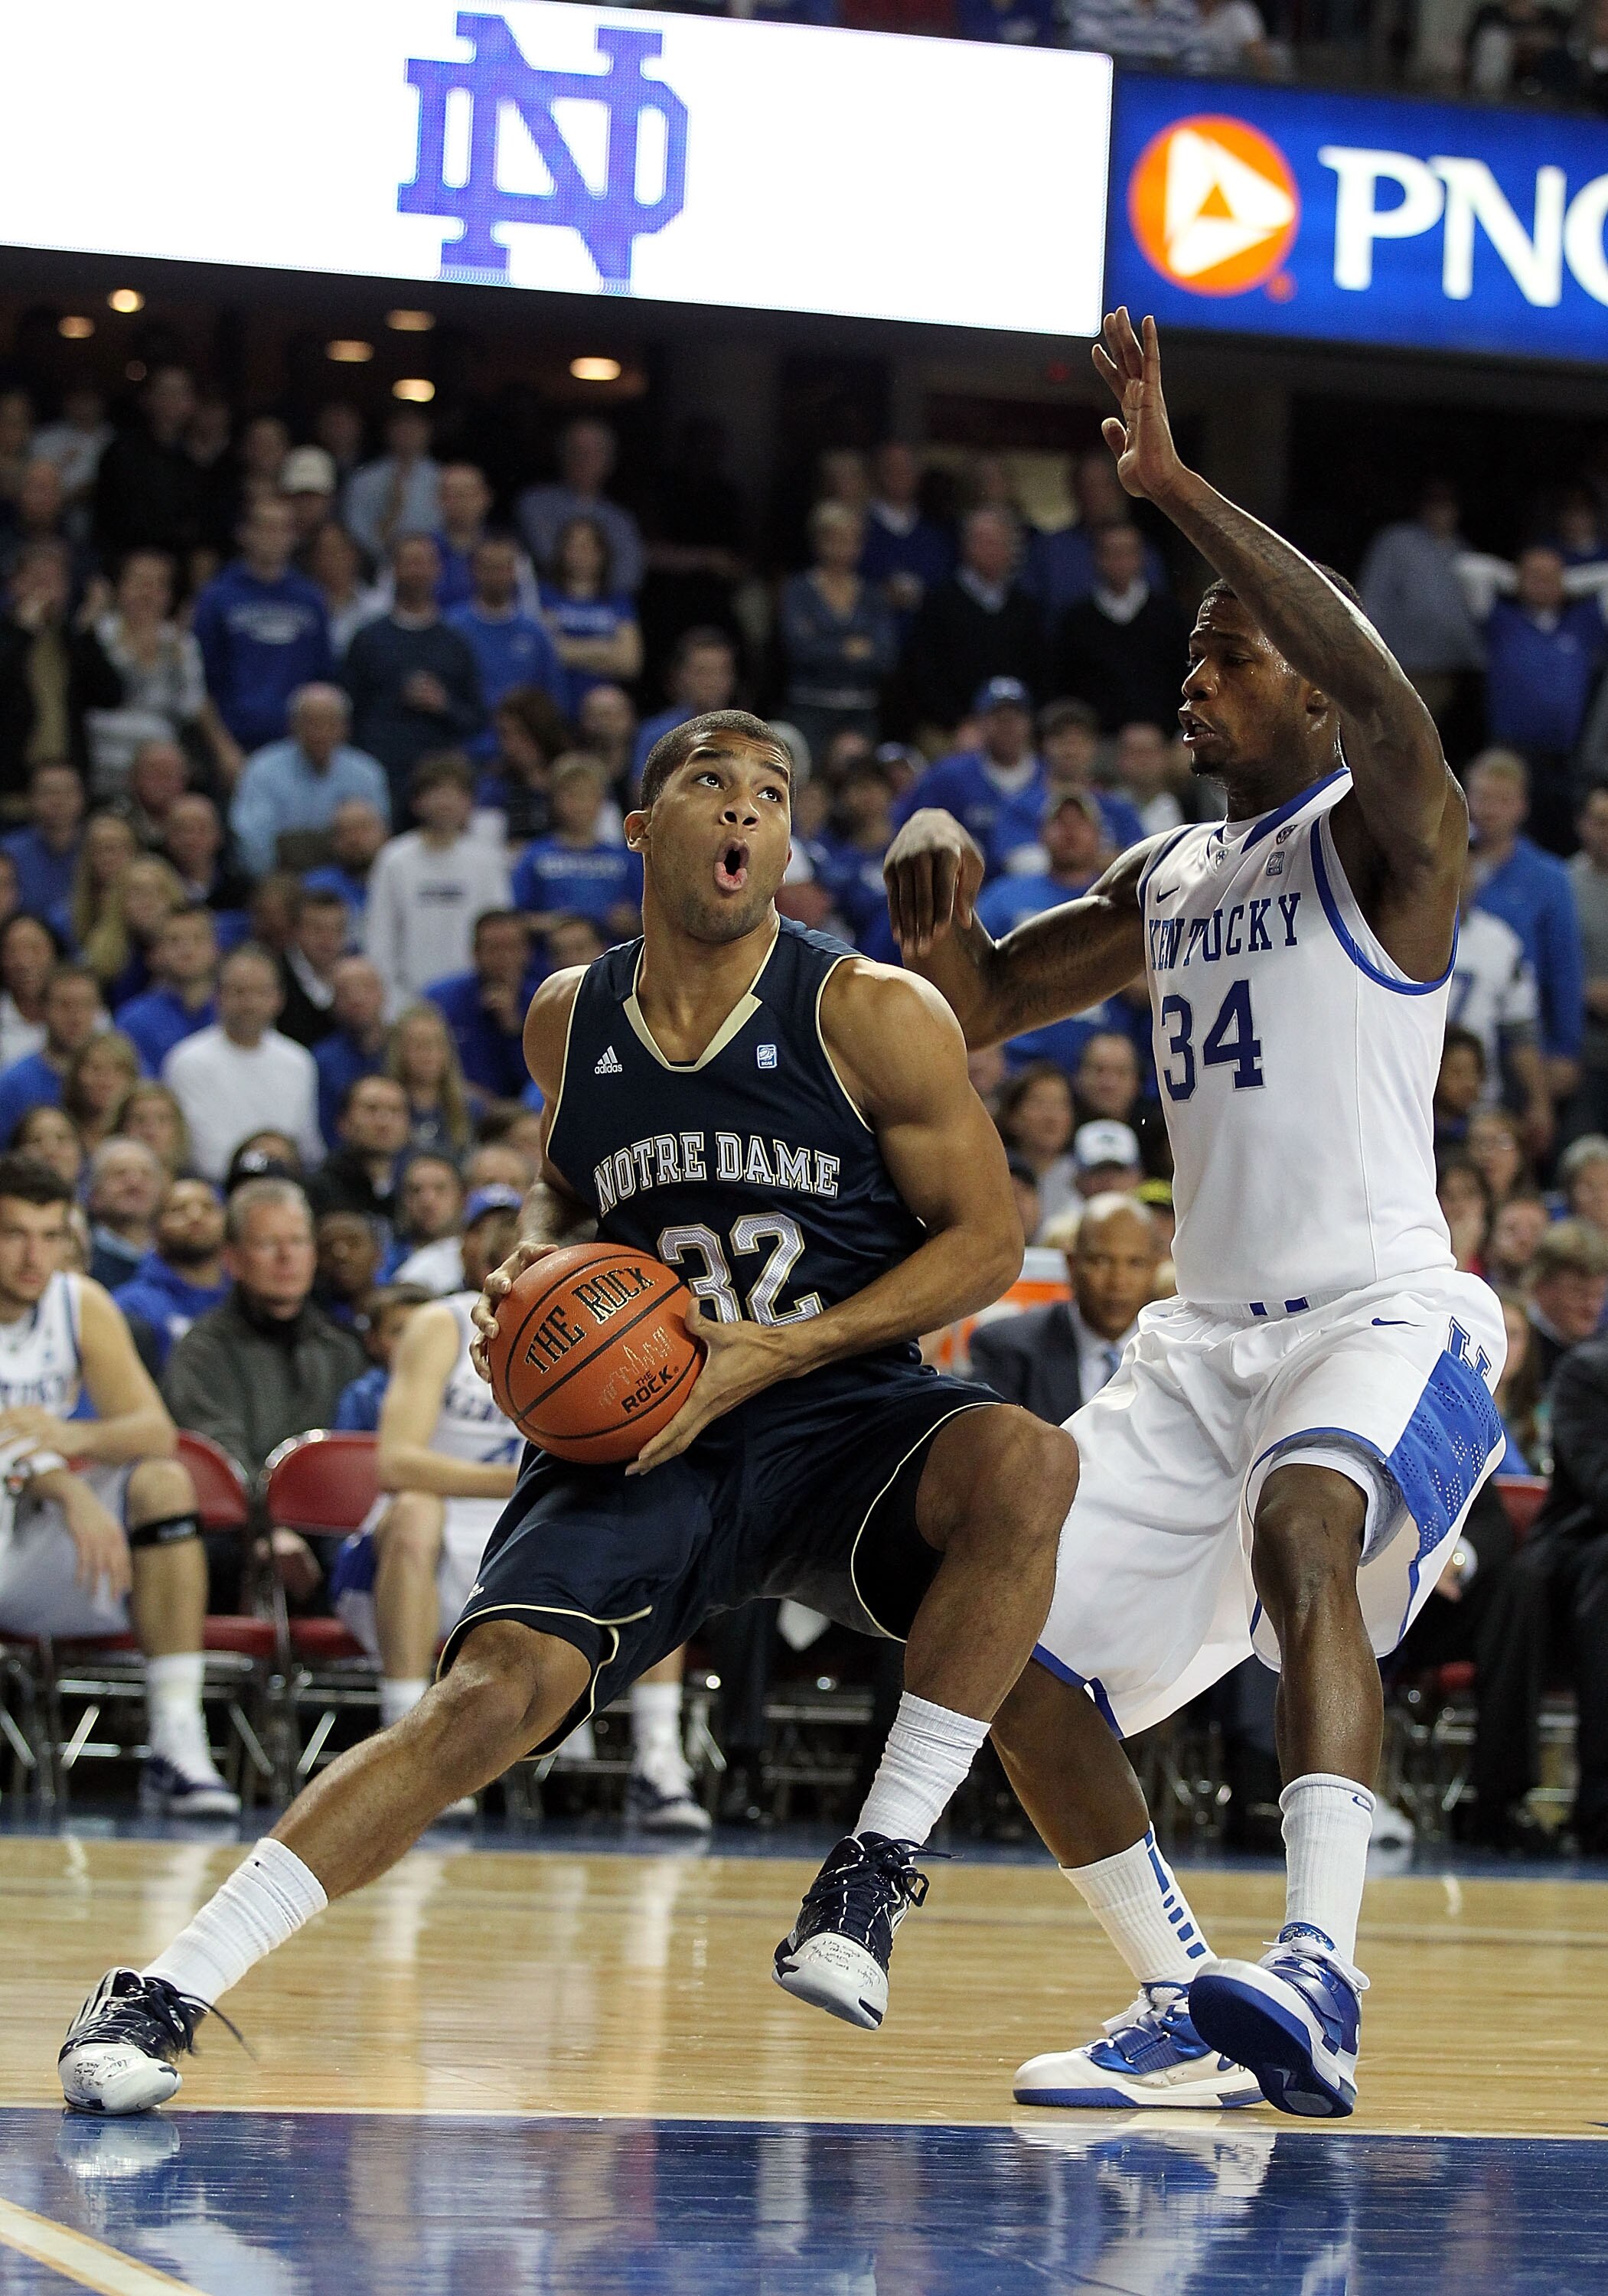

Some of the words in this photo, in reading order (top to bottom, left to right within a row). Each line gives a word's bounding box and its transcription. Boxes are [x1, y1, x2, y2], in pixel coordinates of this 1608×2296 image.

[1149, 891, 1301, 970] KENTUCKY
[594, 1063, 623, 1075] adidas
[1161, 978, 1267, 1102] 34
[593, 1132, 704, 1218] NOTRE
[716, 1132, 840, 1199] DAME
[657, 1212, 824, 1327] 32
[524, 1305, 587, 1375] THE
[570, 1267, 656, 1326] ROCK
[635, 1371, 654, 1387] THE
